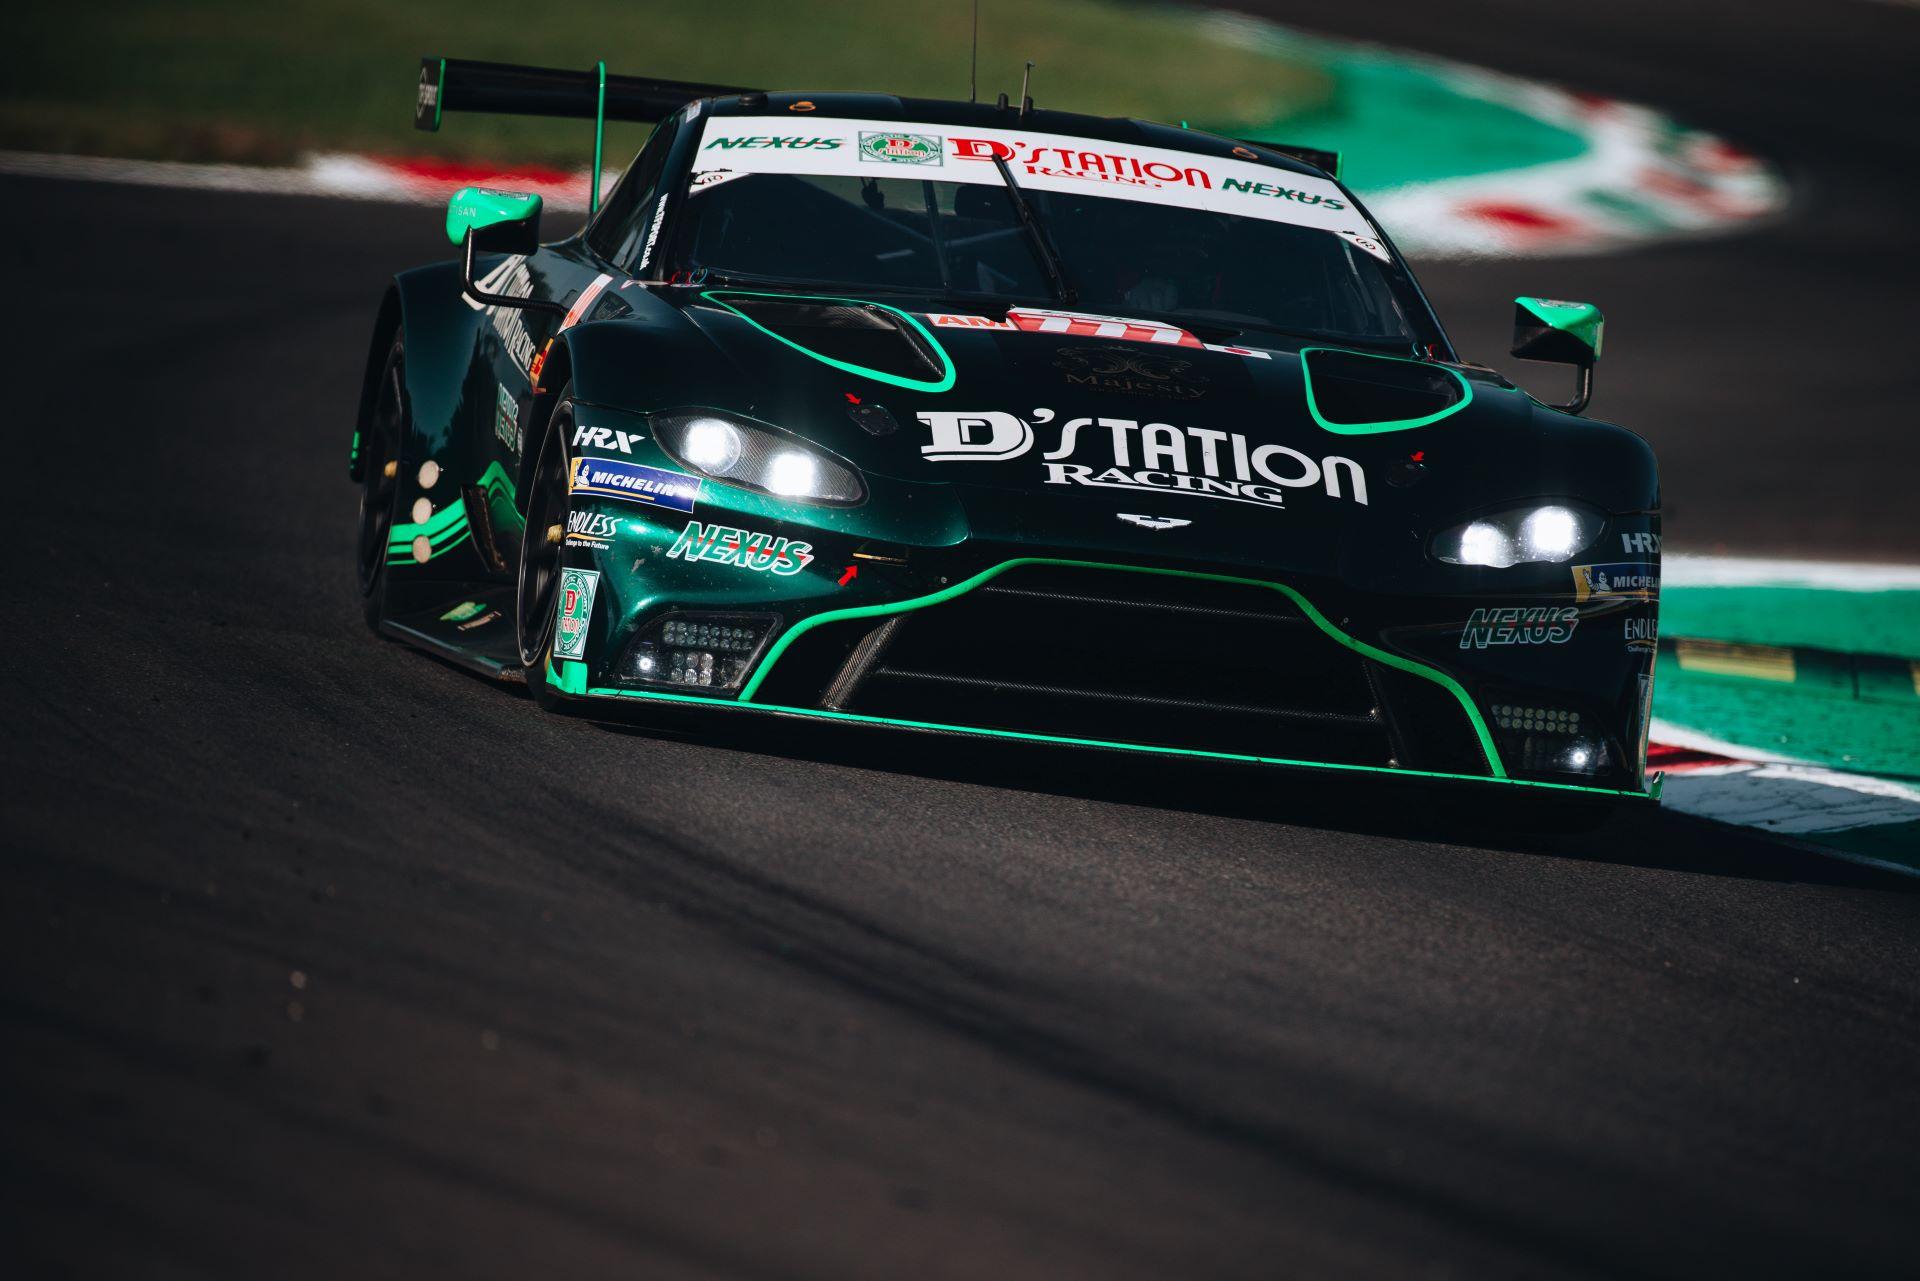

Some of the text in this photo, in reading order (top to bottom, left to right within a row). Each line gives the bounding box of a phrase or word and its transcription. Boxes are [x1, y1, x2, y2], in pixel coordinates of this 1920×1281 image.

[703, 135, 843, 151] NEXUS
[947, 137, 1212, 190] D'STATION
[1222, 177, 1346, 211] NEXUS
[1065, 374, 1207, 400] Majesty
[572, 425, 645, 454] HRX
[916, 407, 1369, 506] D'STATION
[590, 471, 675, 497] MICHELIN
[1043, 461, 1285, 505] RACING
[566, 511, 624, 538] ENDLESS
[666, 520, 814, 577] NEXUS
[1459, 607, 1580, 650] NEXUS
